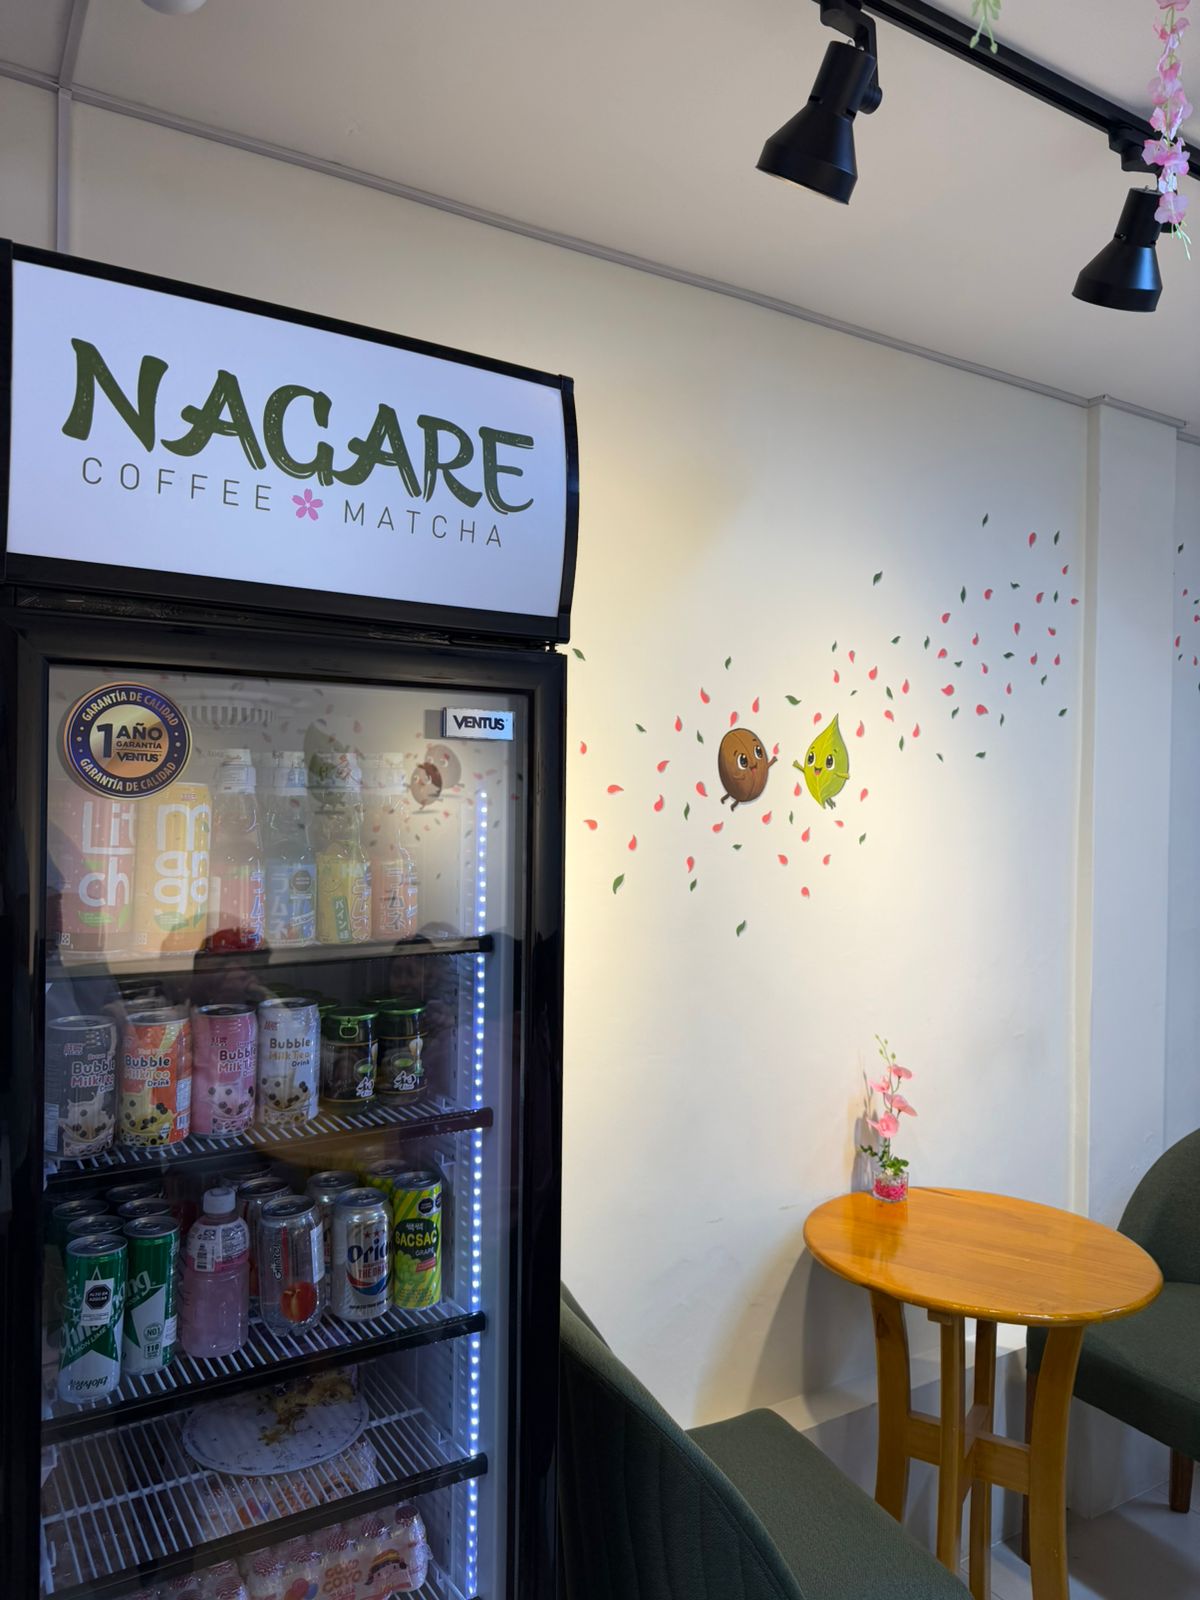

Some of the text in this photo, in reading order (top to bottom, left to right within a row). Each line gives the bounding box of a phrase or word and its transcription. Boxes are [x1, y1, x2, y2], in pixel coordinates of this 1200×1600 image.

[62, 338, 535, 516] NAGARE
[82, 457, 502, 548] COFFEE MATCHA
[81, 690, 179, 727] GARANTÍA DE CALIDAD
[453, 715, 505, 731] VENTUS
[96, 722, 163, 759] 1 AÑO
[116, 740, 162, 750] GARANTÍA
[116, 751, 159, 763] VENTUS
[80, 758, 176, 792] GARANTÍA DE CALIDAD
[269, 1037, 311, 1049] Bubble
[125, 1054, 171, 1067] Bubble
[146, 1078, 170, 1088] Drink
